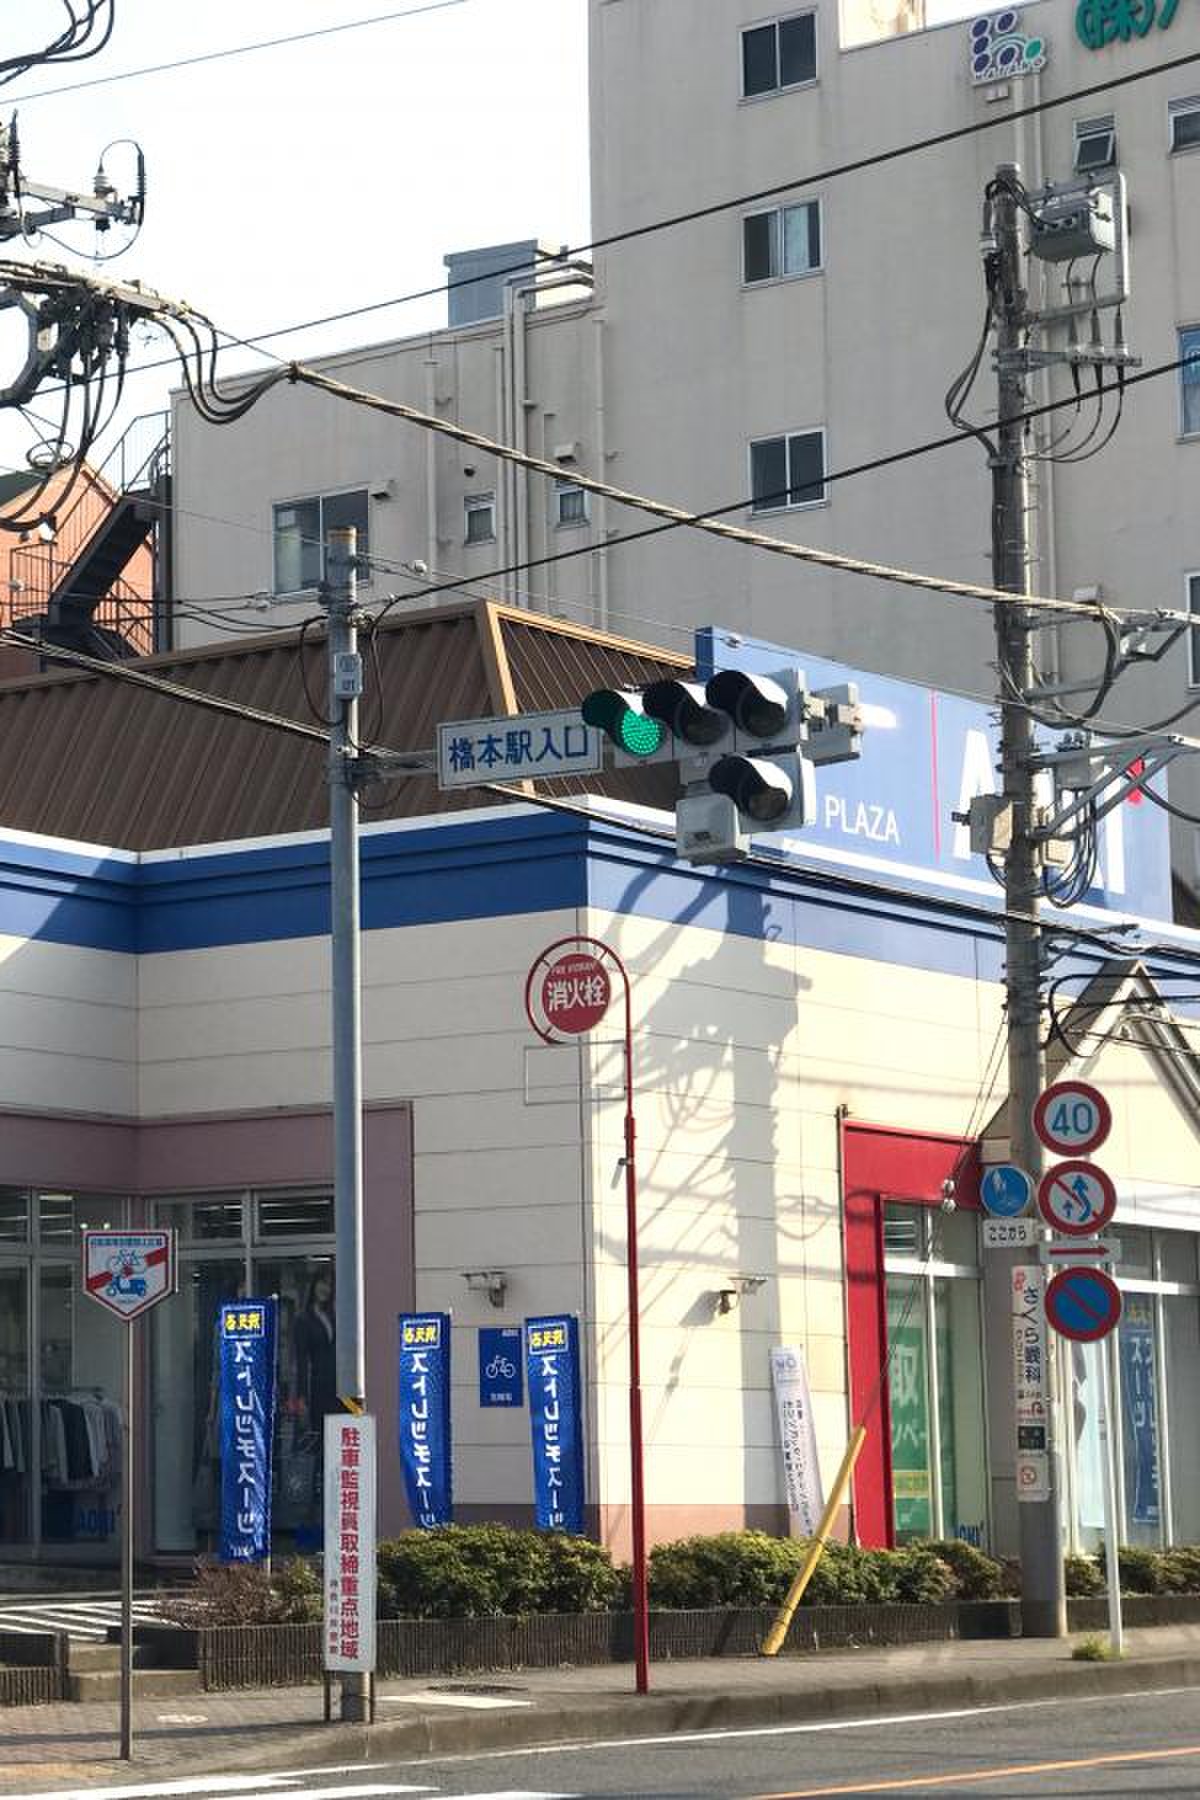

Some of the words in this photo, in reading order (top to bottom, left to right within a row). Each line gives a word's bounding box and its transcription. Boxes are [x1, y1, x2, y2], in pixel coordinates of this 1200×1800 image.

[448, 725, 588, 773] 橋本駅入口
[825, 796, 901, 848] PLAZA
[547, 975, 606, 1012] 消火栓
[1052, 1103, 1093, 1136] 40
[988, 1225, 1027, 1241] ここから
[340, 1427, 360, 1660] 駐車監視員取締重点地域
